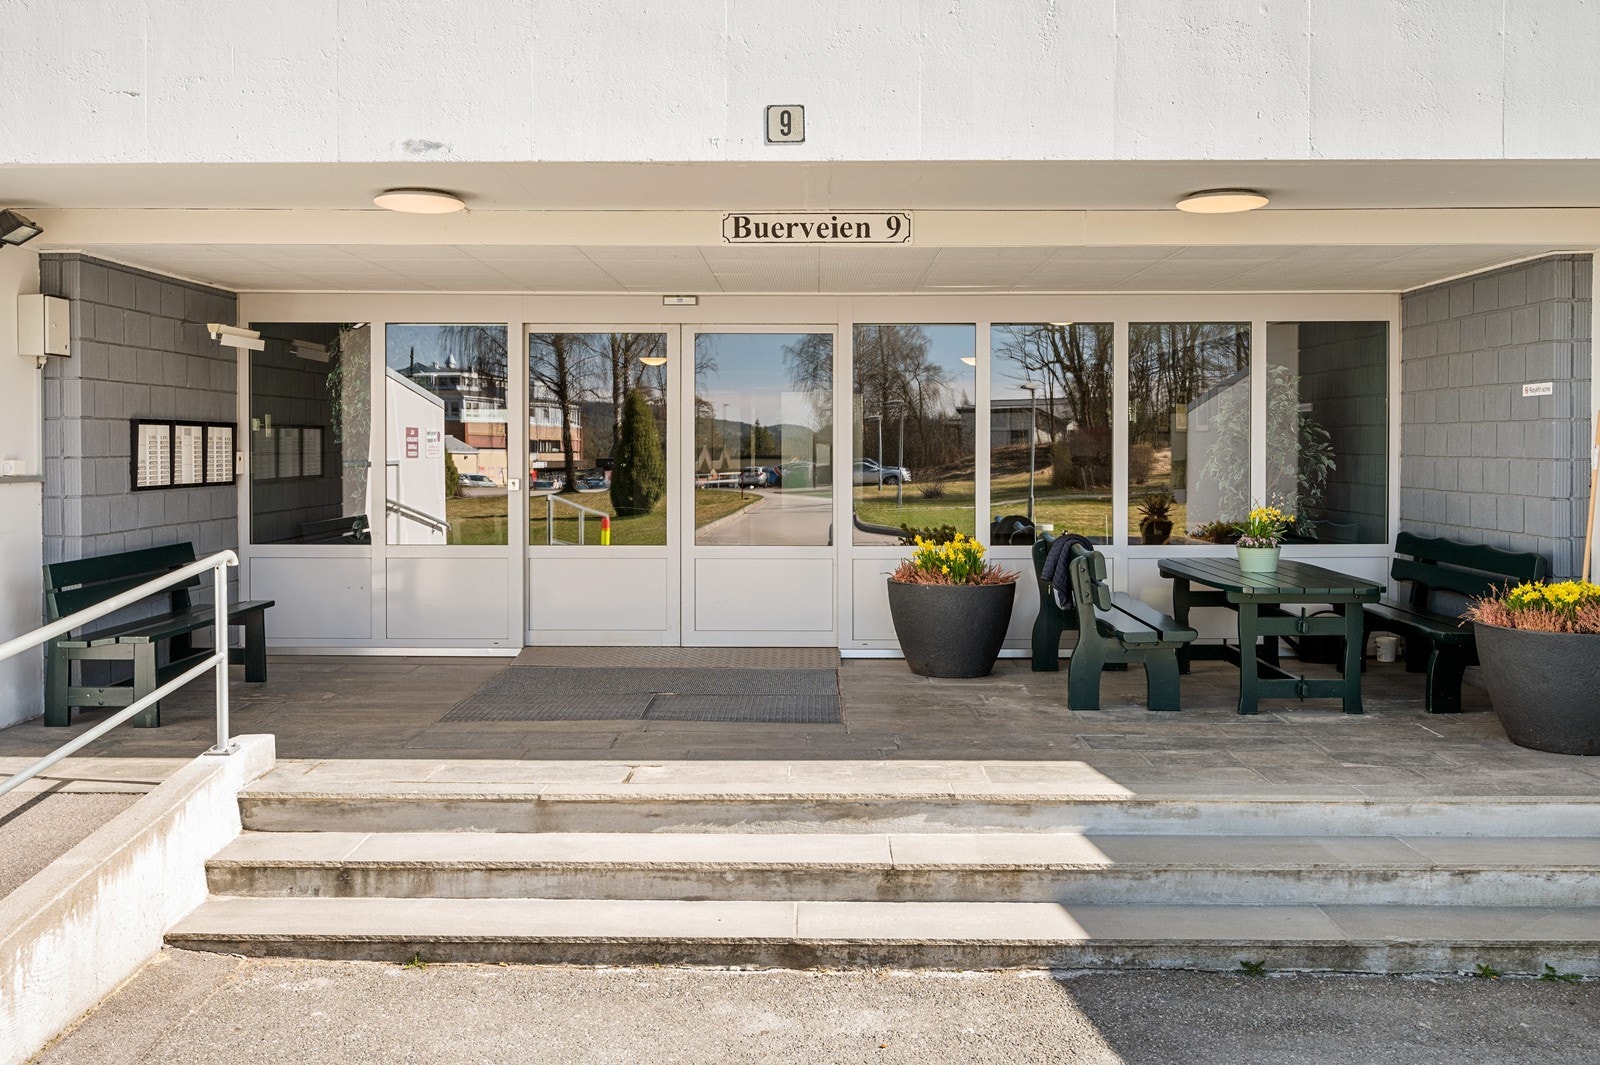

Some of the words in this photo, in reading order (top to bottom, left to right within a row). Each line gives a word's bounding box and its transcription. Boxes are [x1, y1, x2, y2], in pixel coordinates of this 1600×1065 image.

[780, 110, 792, 136] 9
[731, 216, 871, 239] Buerveien
[886, 216, 901, 239] 9
